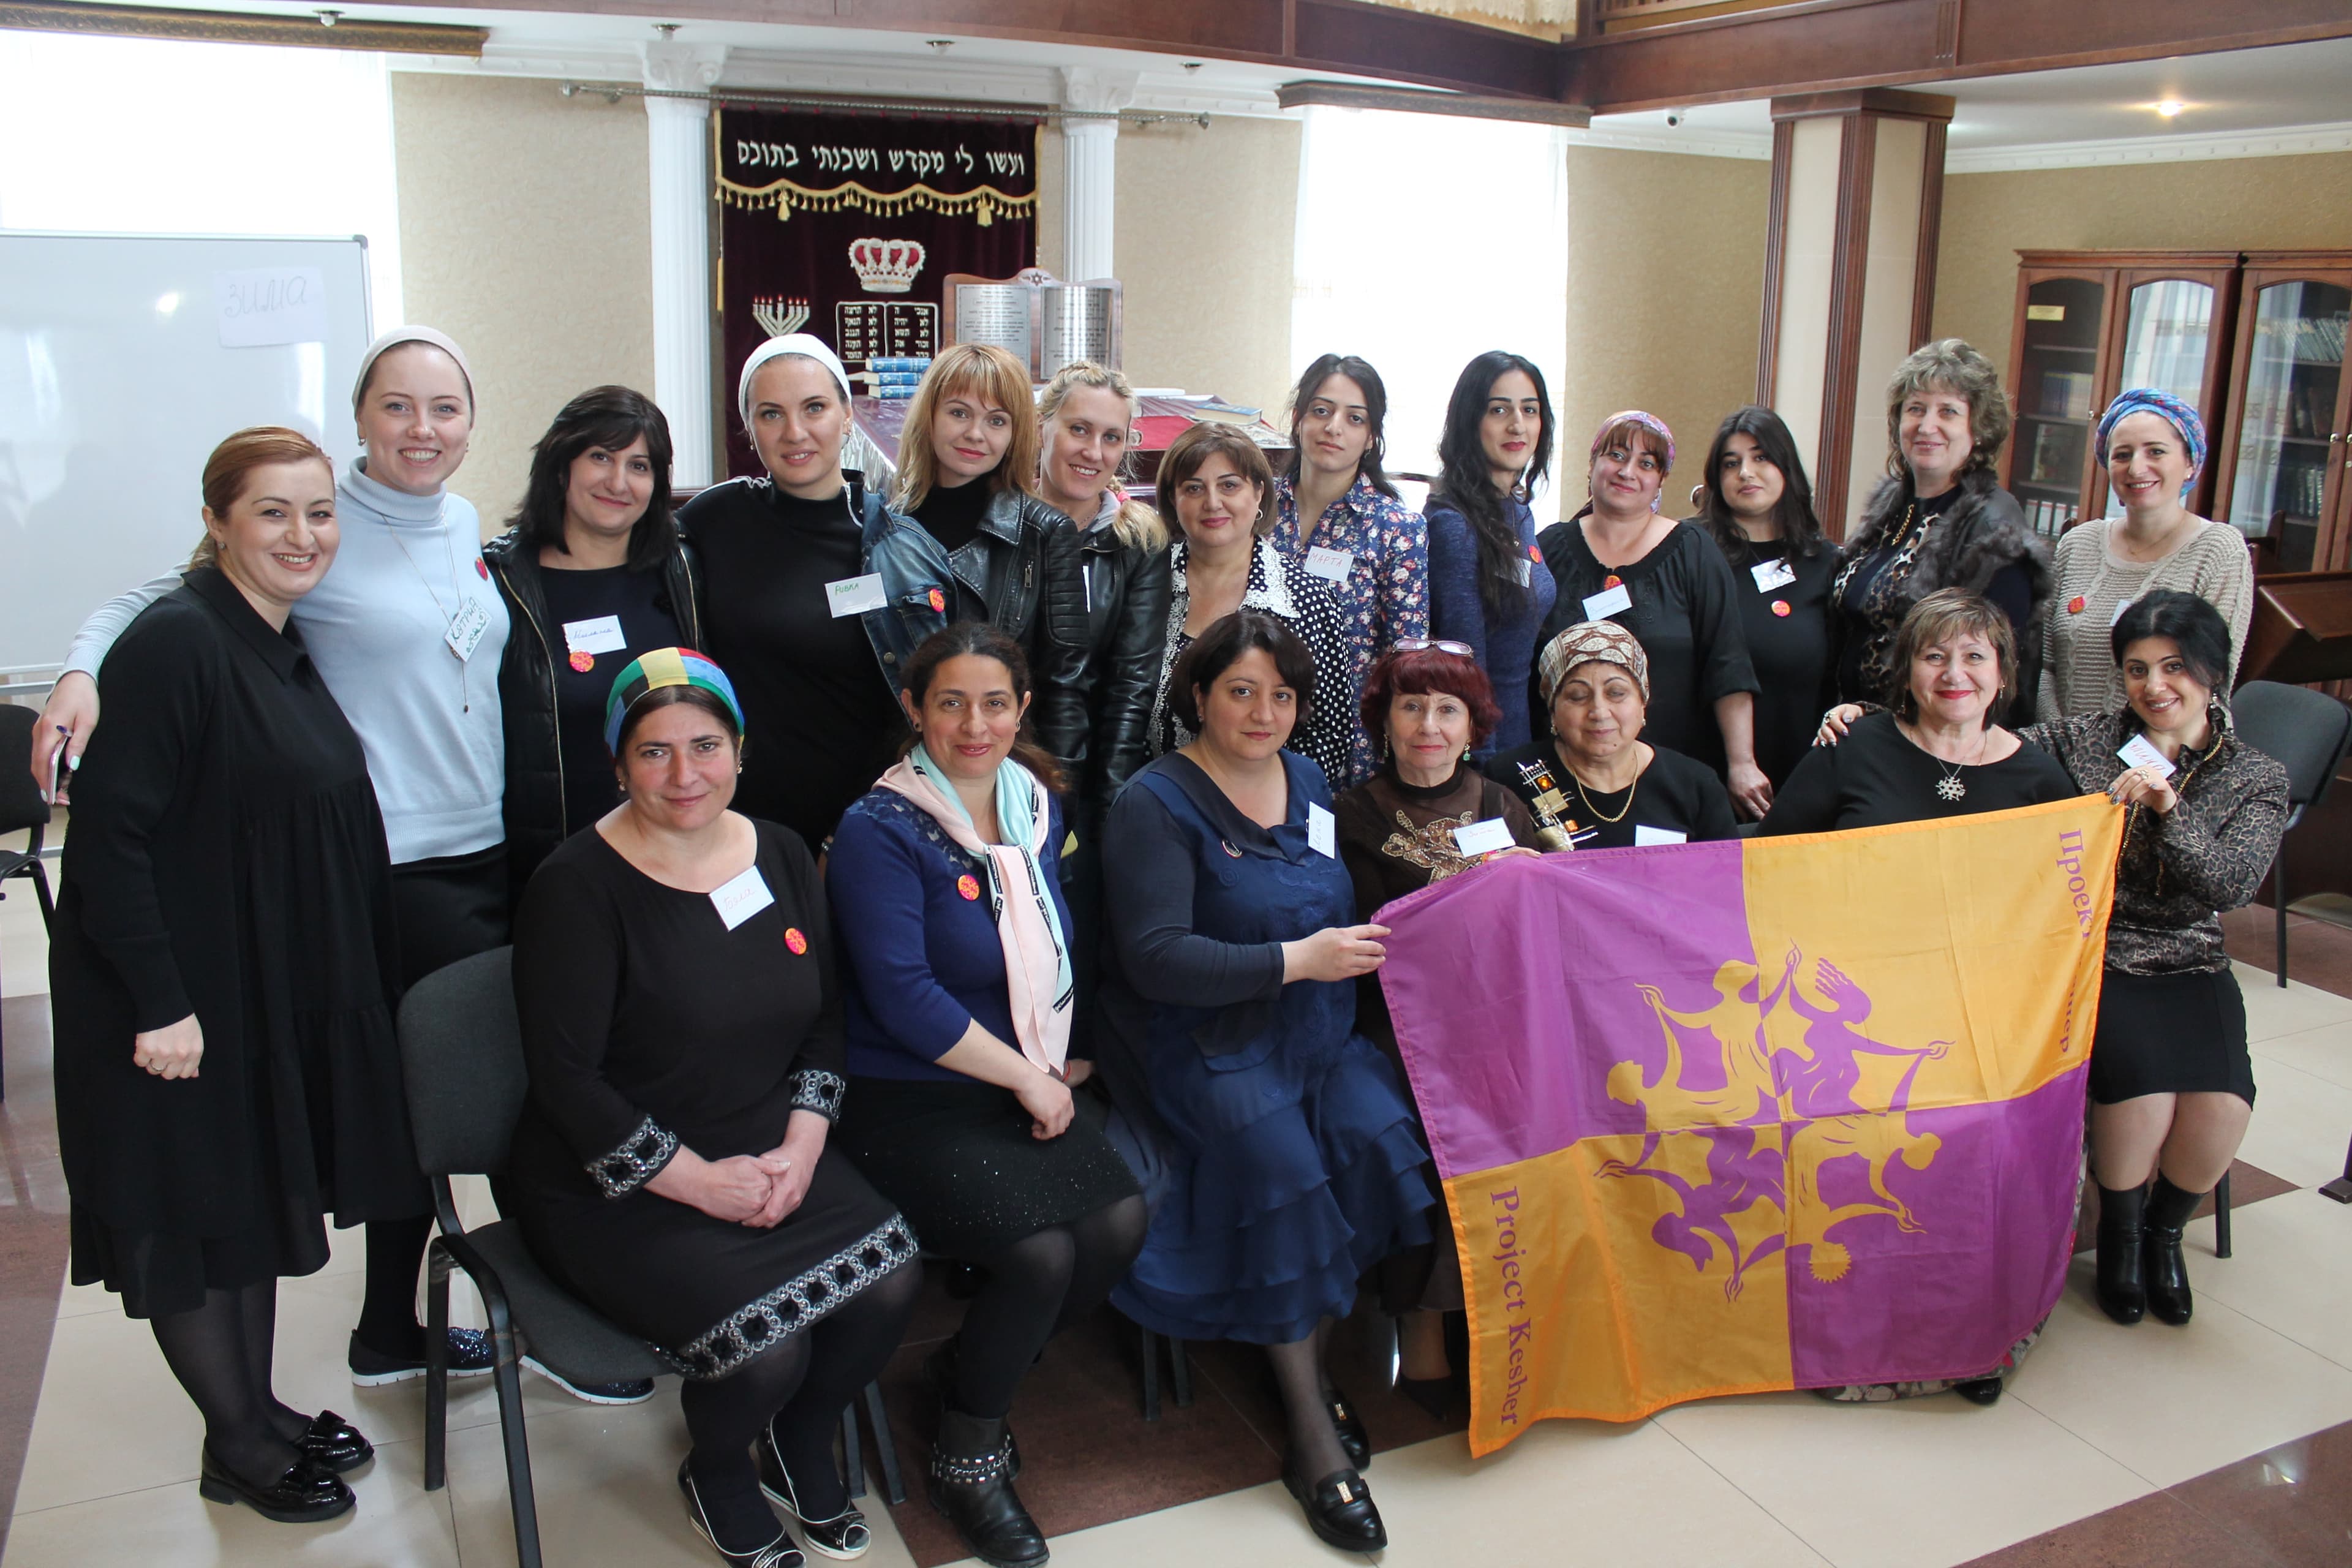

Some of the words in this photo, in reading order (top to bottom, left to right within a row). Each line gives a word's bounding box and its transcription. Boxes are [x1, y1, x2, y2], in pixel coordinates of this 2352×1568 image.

[812, 145, 879, 172] ושכנתי
[888, 148, 945, 179] מקדש
[955, 143, 974, 175] לי
[986, 151, 1025, 177] ועשו
[868, 305, 878, 314] לא
[868, 315, 878, 326] לא
[919, 316, 929, 326] לא
[868, 326, 878, 337] לא
[919, 328, 929, 337] לא
[869, 337, 878, 349] לא
[1311, 552, 1343, 567] МАРТА
[1490, 1185, 1526, 1313] Project
[1501, 1317, 1531, 1425] Kesher
